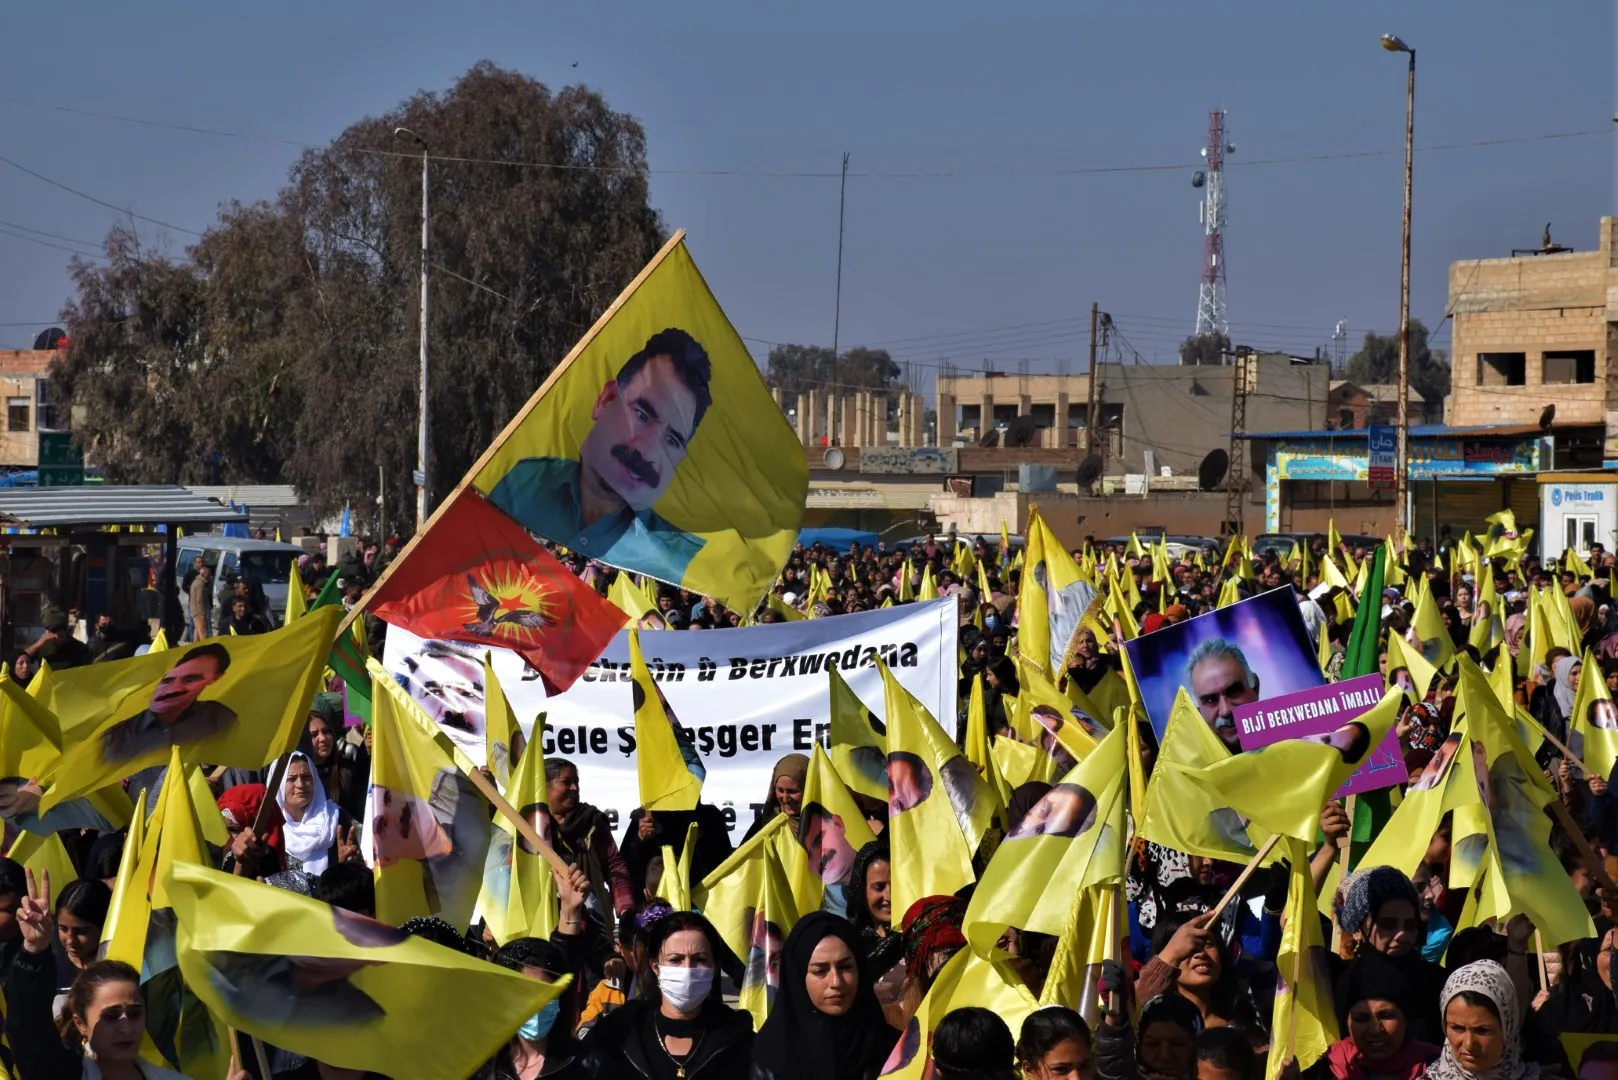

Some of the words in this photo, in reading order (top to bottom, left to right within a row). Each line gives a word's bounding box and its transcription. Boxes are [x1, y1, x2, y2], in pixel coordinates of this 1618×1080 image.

[728, 641, 918, 681] Berxwedana
[1241, 711, 1266, 734] BIJÎ
[1267, 697, 1340, 728] BERXWEDANA
[617, 723, 777, 758] Şeşger
